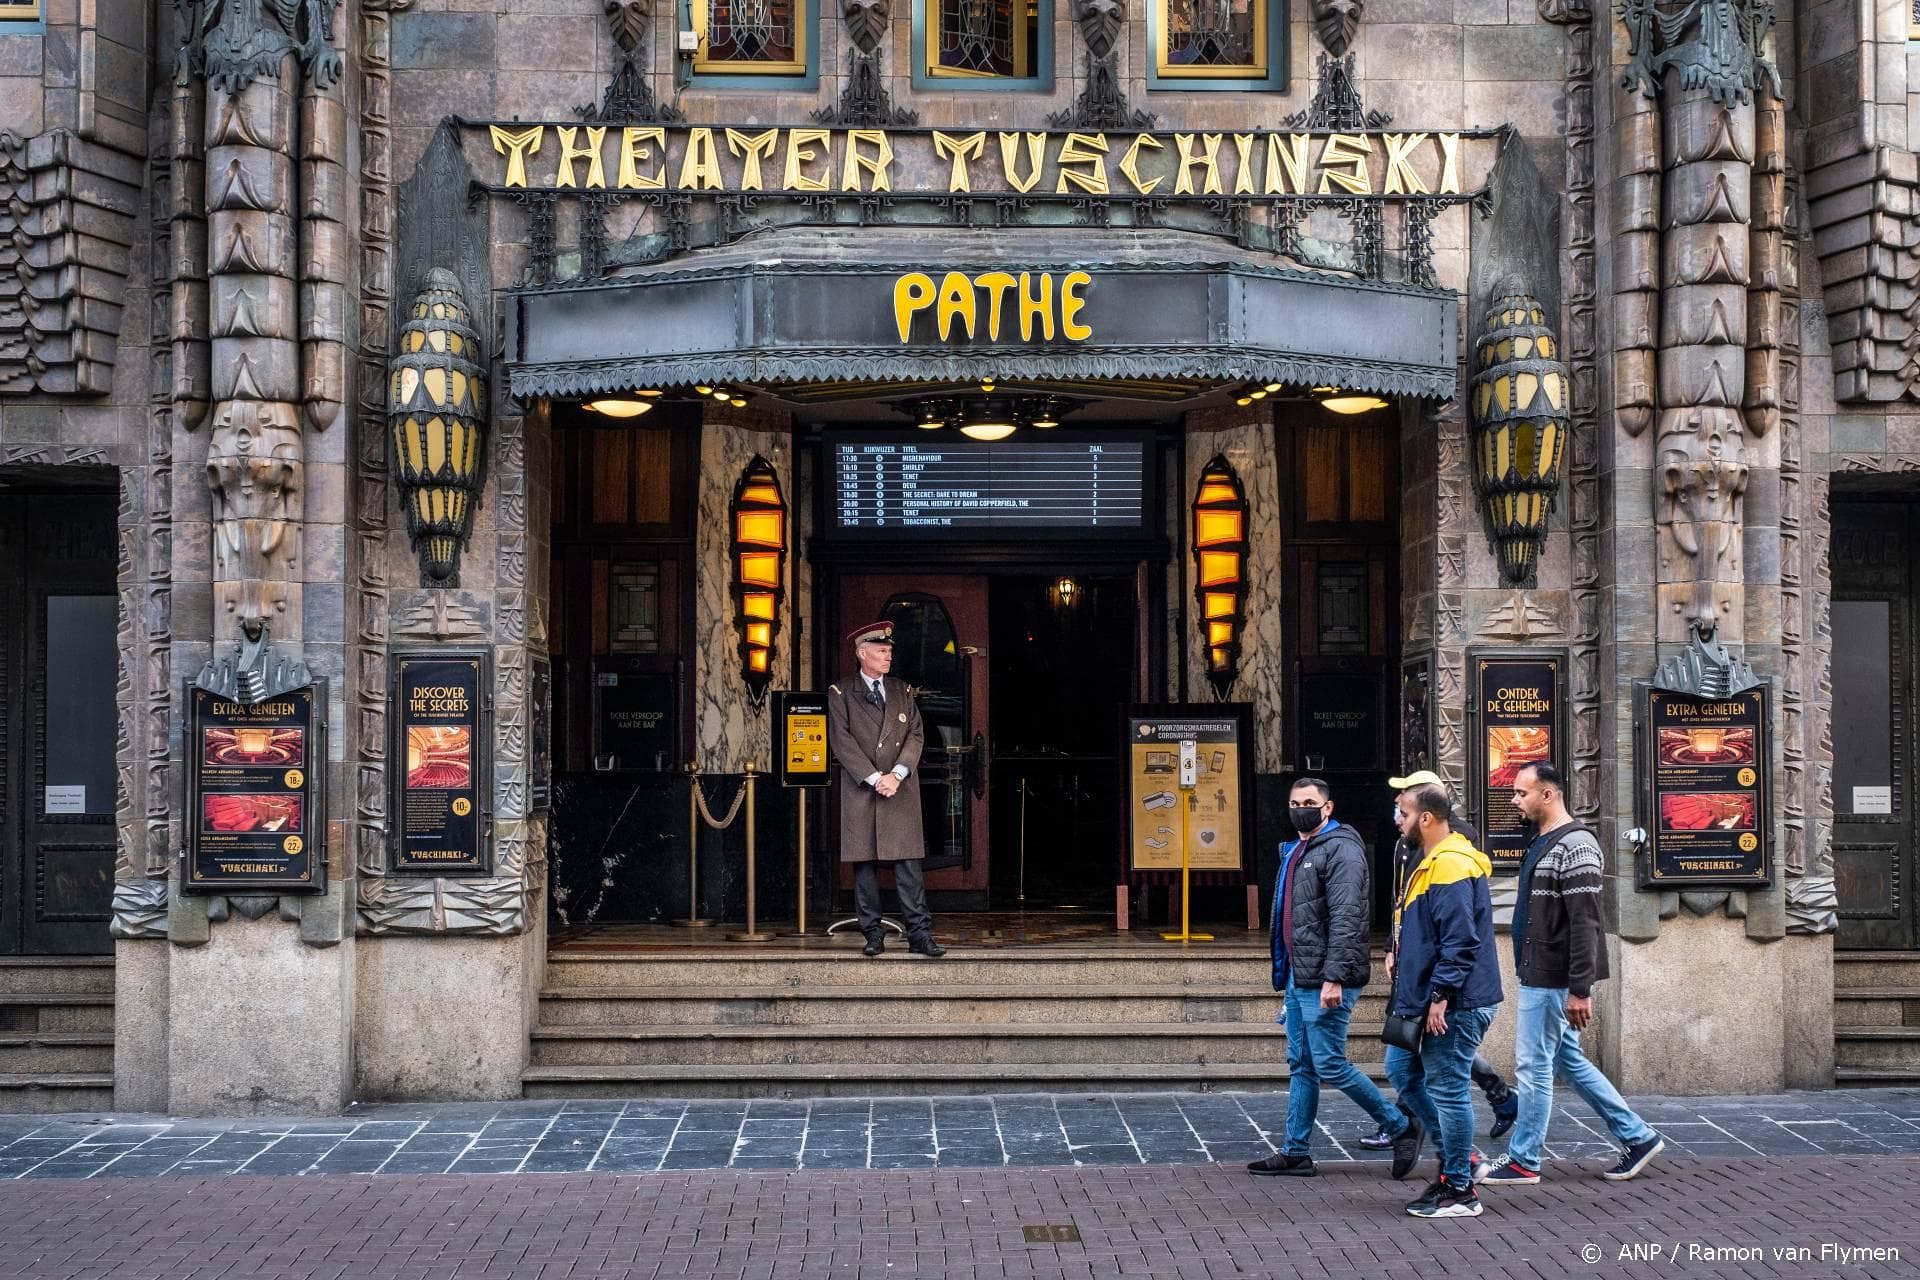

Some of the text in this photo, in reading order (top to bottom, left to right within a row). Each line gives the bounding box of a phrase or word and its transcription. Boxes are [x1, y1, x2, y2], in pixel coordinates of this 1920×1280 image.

[489, 124, 1460, 196] THEATER TUSCHINSKI
[893, 271, 1093, 344] PATHE
[1089, 445, 1103, 453] ZAAL
[413, 687, 465, 699] DISCOVER
[1497, 687, 1540, 700] ONTDEK
[213, 702, 295, 716] EXTRA GENIETEN
[409, 699, 470, 712] THE SECRETS
[1487, 700, 1549, 712] DE GEHEIMEN
[1666, 702, 1745, 716] EXTRA GENIETEN
[410, 850, 461, 859] TUSCHINSKI
[1492, 849, 1525, 857] TUSCHI
[220, 863, 278, 873] TUSCHINSKI
[1680, 861, 1735, 871] TUSCHINSKI
